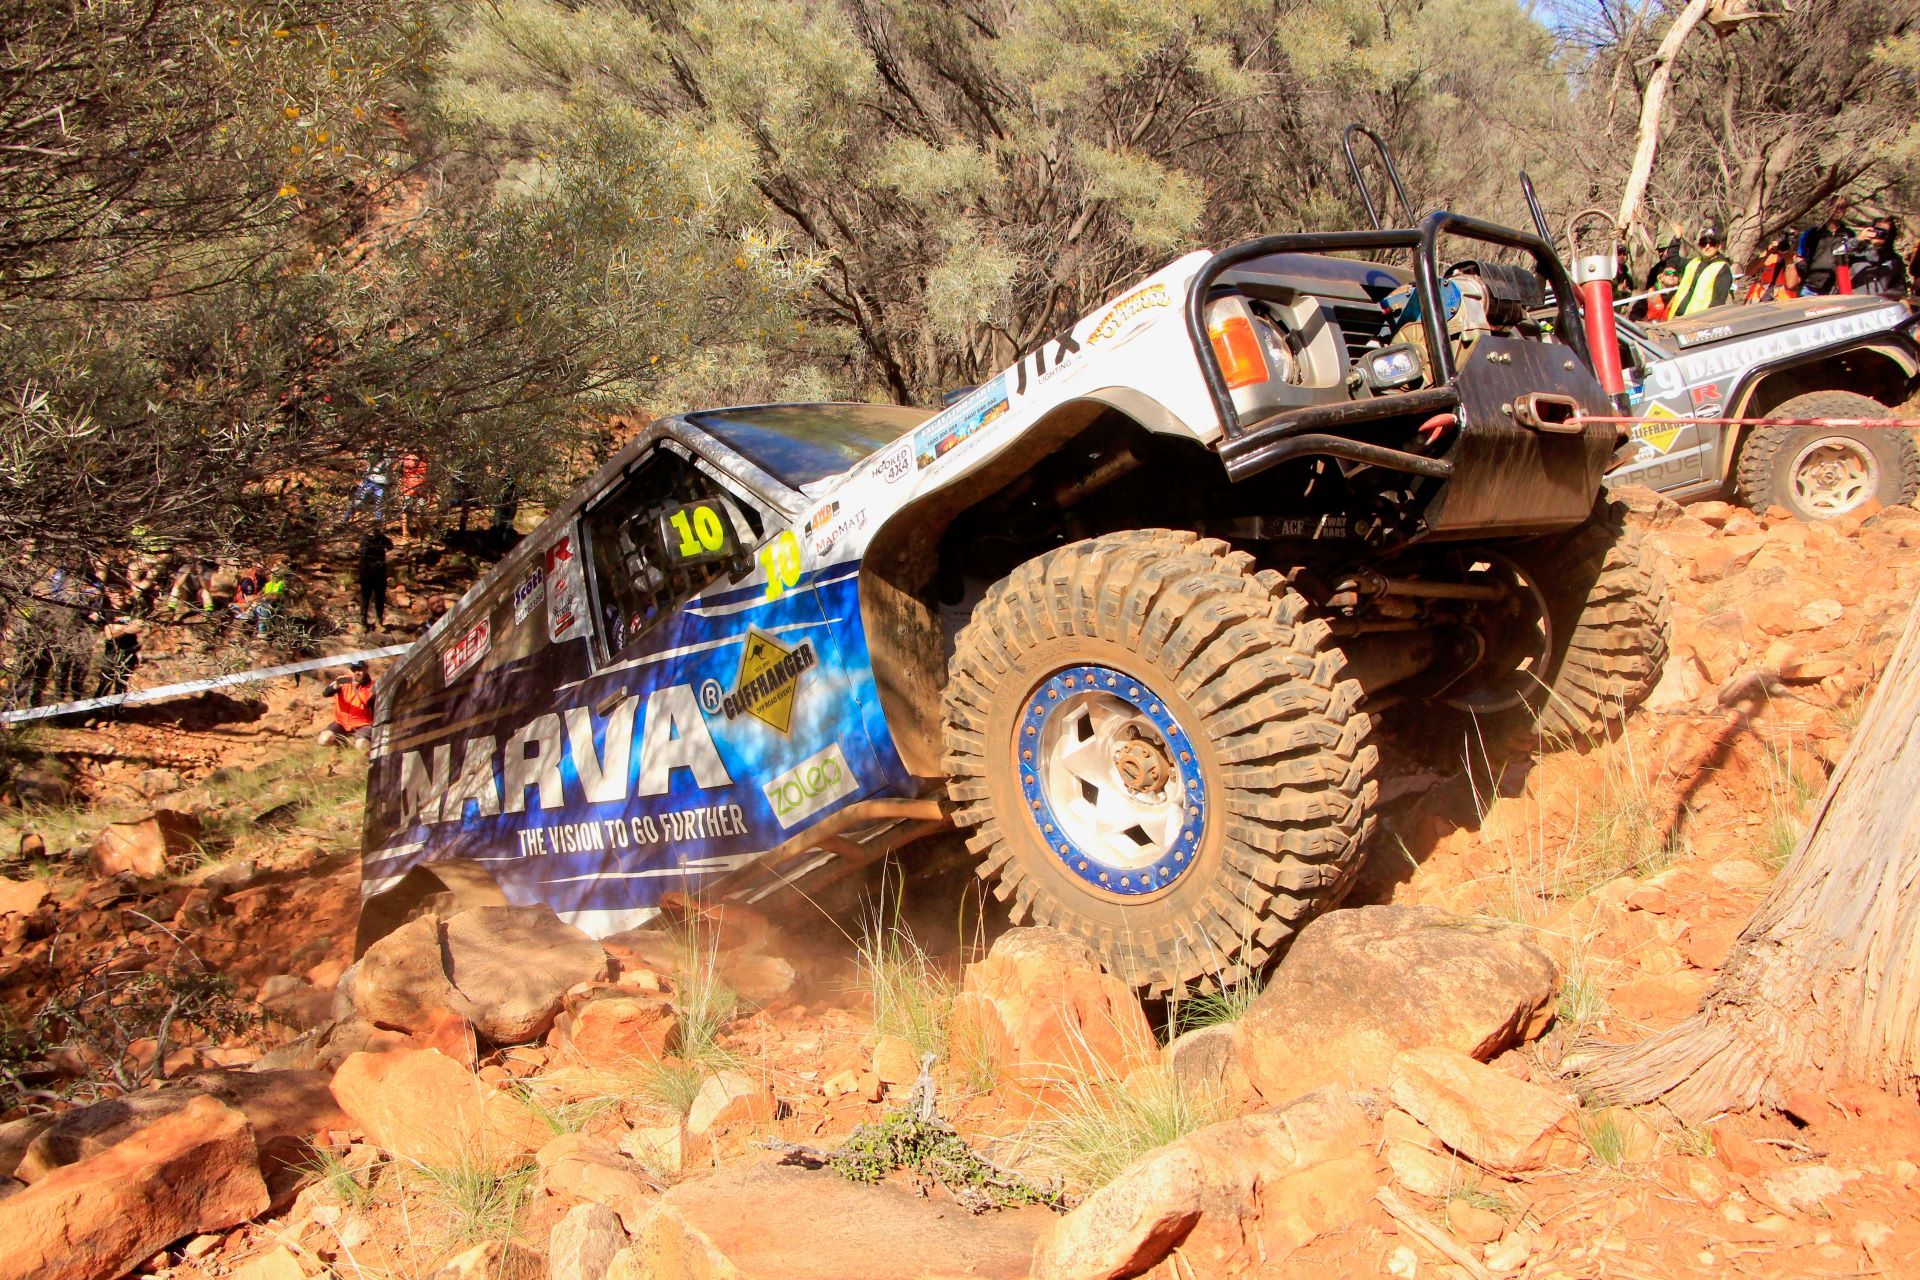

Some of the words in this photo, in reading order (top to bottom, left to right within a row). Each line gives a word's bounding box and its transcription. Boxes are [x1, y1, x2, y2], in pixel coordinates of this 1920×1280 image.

[1687, 337, 1788, 380] DAKOTA
[1800, 306, 1898, 349] RACING
[1038, 359, 1072, 385] LIGHTING
[1655, 362, 1685, 400] 9
[669, 506, 724, 557] 10
[815, 508, 866, 553] MADMATT
[1281, 520, 1304, 536] ACE
[760, 529, 801, 602] 10
[723, 643, 814, 720] CLIFFHANGER
[765, 696, 778, 709] ROAD
[400, 684, 733, 826] NARVA
[518, 828, 547, 857] THE
[548, 822, 603, 855] VISION
[604, 816, 629, 849] TO
[631, 814, 660, 845] GO
[661, 804, 748, 842] FURTHER
